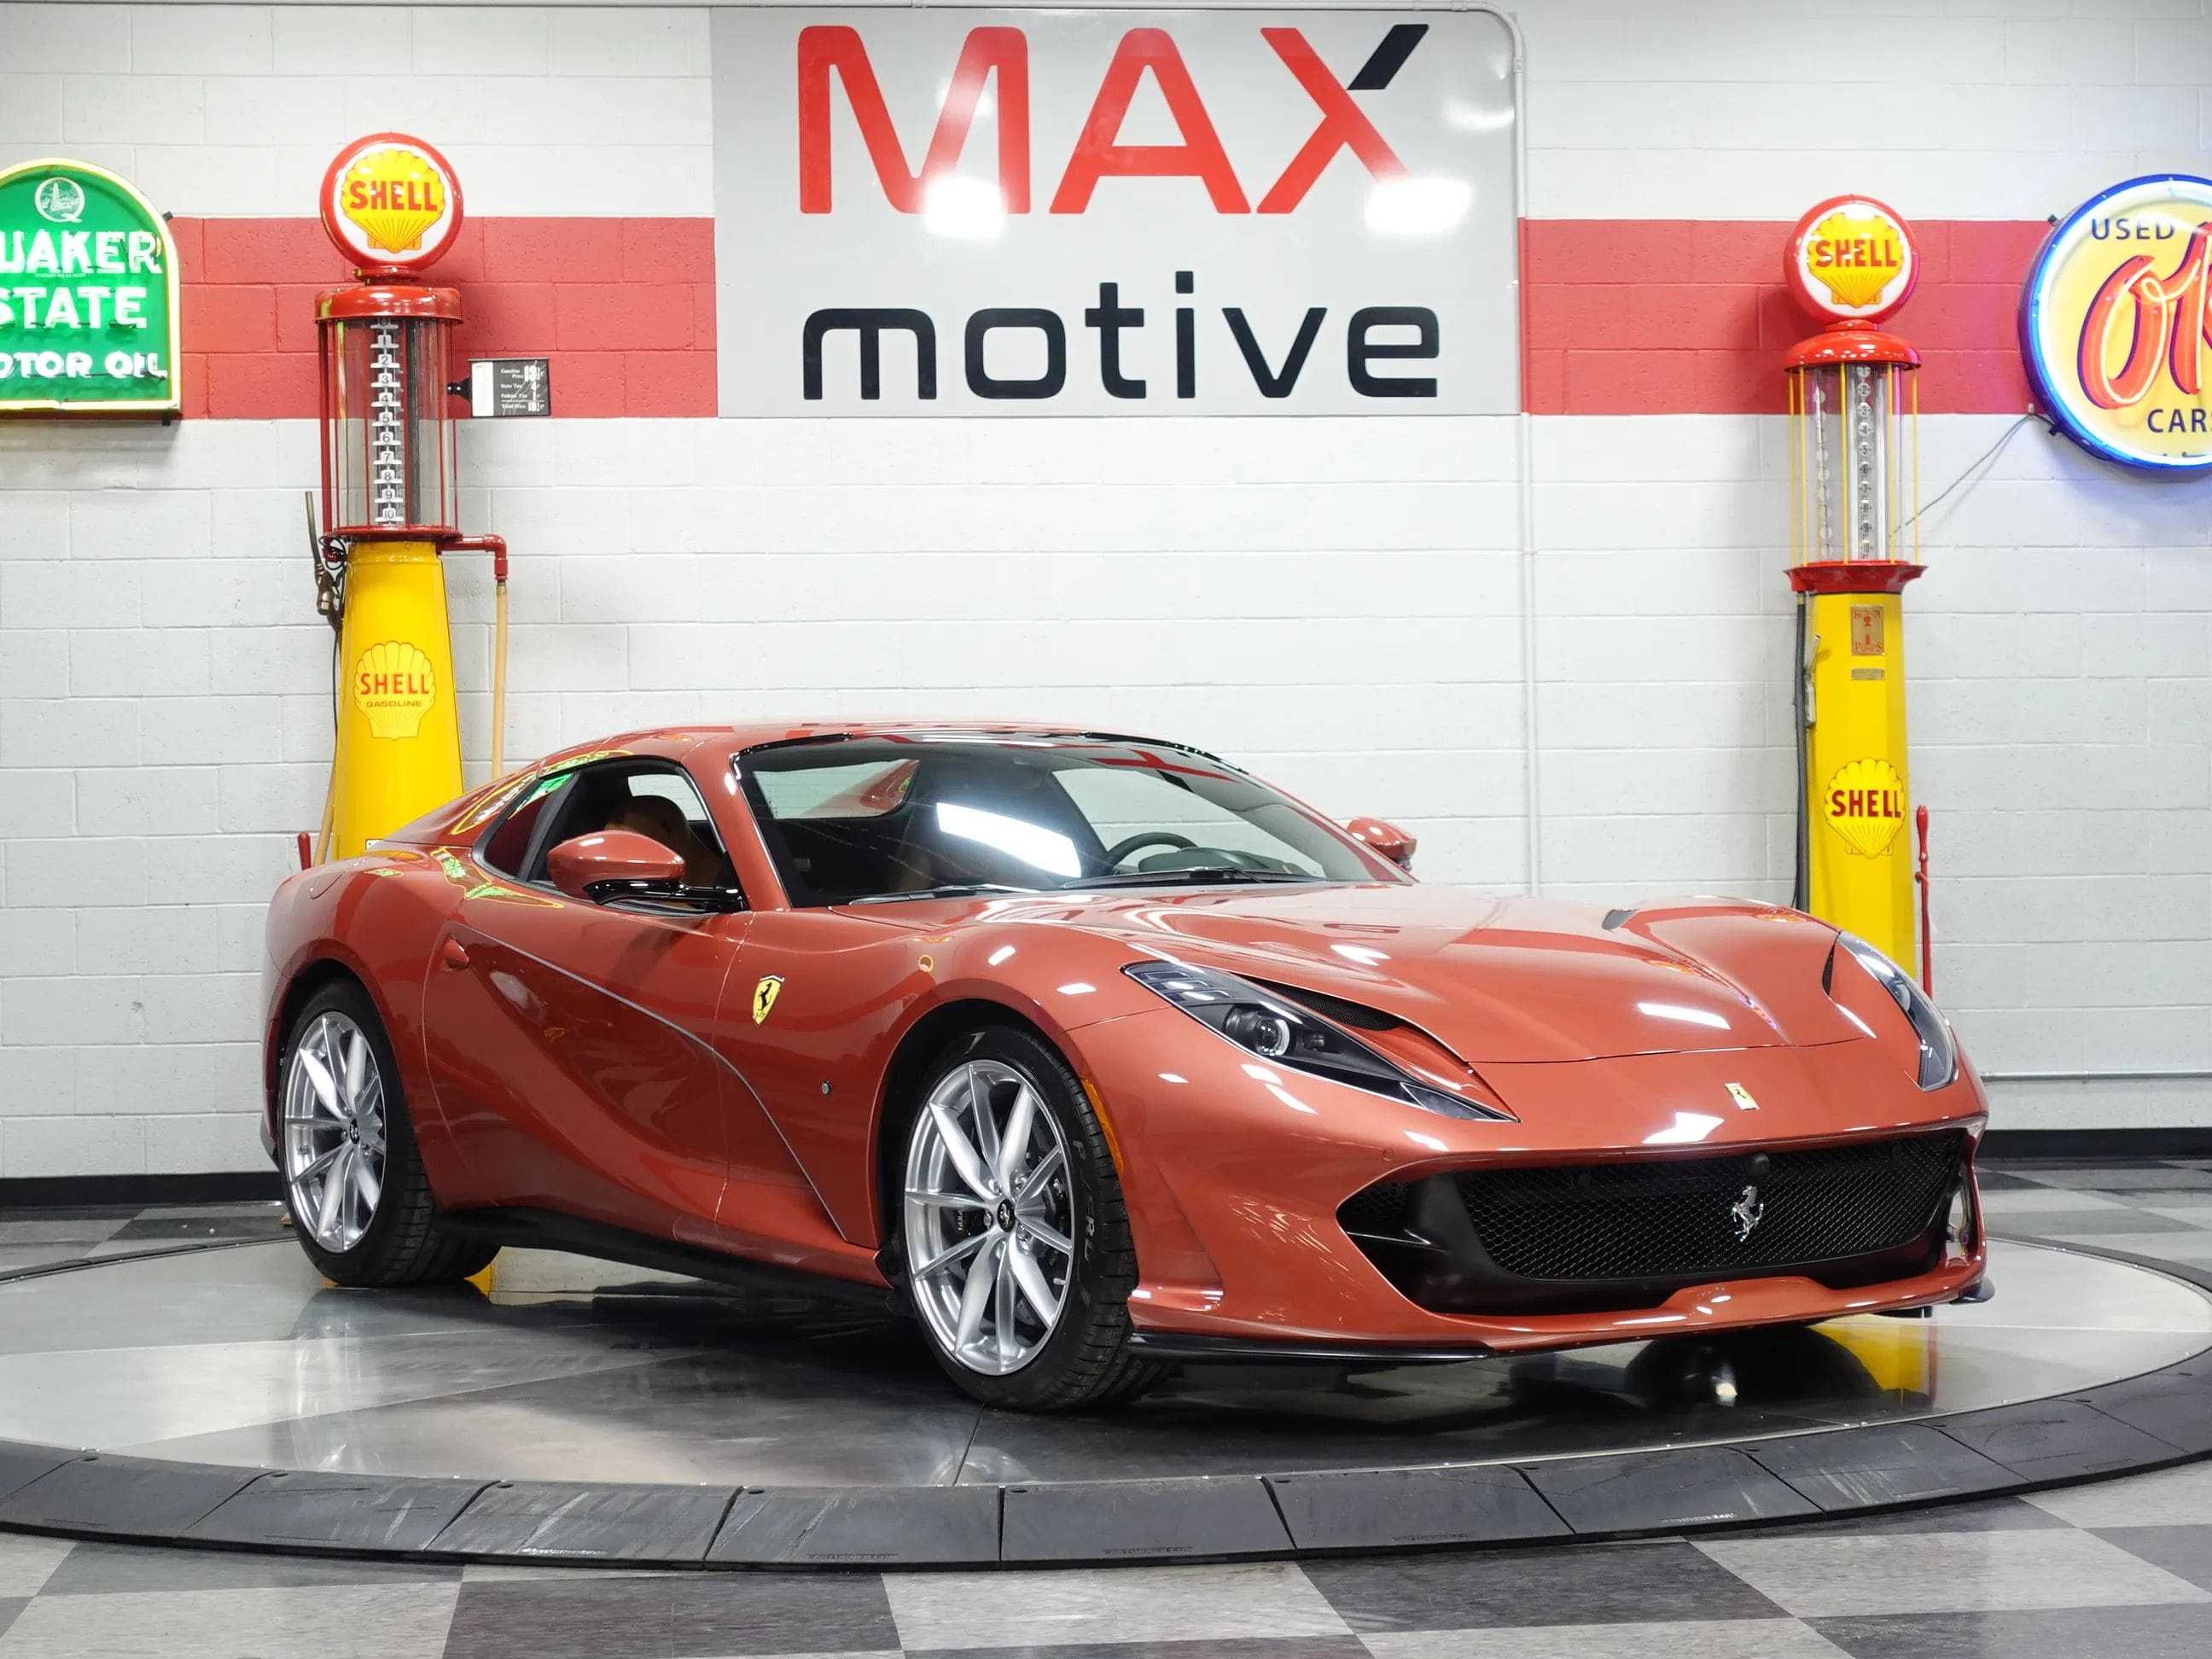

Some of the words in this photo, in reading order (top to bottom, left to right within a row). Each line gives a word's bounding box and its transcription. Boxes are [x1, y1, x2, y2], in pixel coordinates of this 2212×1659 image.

[797, 24, 1429, 214] MAX
[350, 180, 438, 212] SHELL
[2091, 218, 2175, 240] USED
[1815, 239, 1897, 267] SHELL
[802, 271, 1440, 400] motive
[105, 351, 168, 378] OIL
[381, 355, 388, 365] 2
[381, 375, 389, 385] 3
[381, 394, 389, 404] 4
[382, 413, 390, 423] 5
[2147, 408, 2212, 434] CAR
[382, 433, 390, 443] 6
[384, 452, 391, 463] 7
[384, 471, 392, 481] 8
[385, 490, 393, 500] 9
[360, 672, 429, 696] SHELL
[1831, 789, 1901, 818] SHELL
